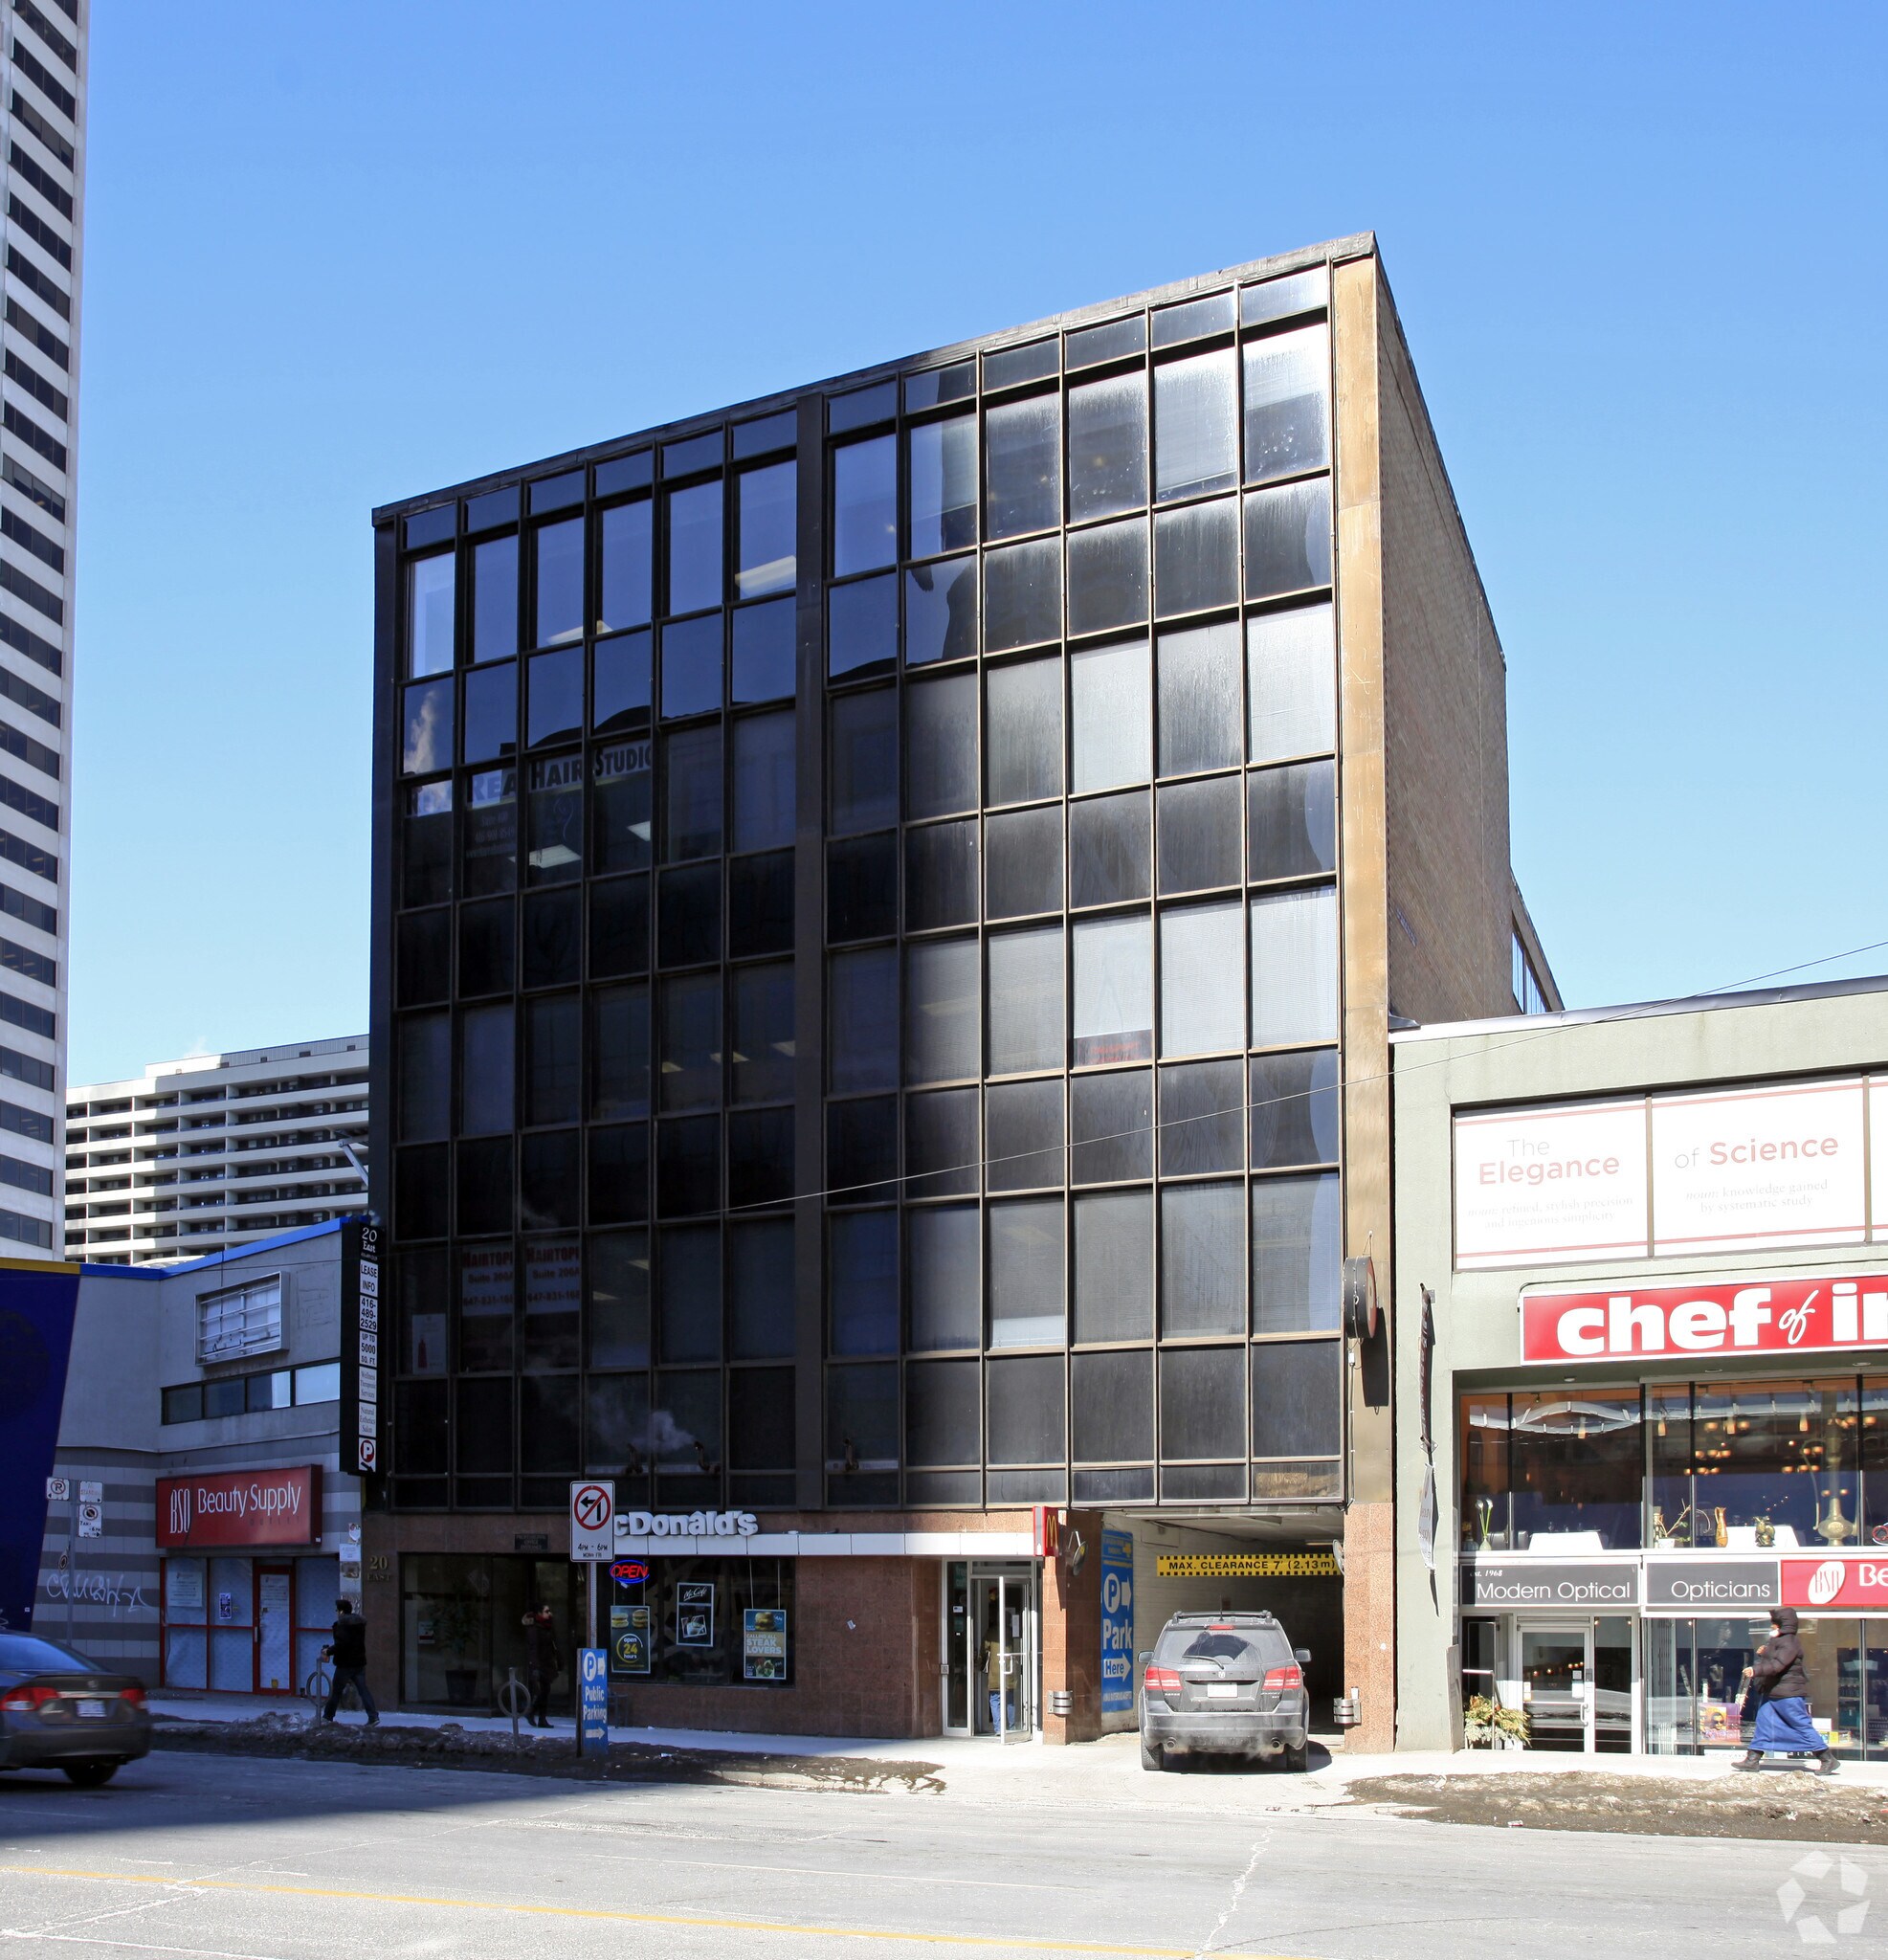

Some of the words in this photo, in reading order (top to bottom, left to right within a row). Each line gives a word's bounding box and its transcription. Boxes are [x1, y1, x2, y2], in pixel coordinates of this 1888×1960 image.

[531, 759, 582, 790] HAIR
[1506, 1138, 1550, 1157] The
[1675, 1147, 1699, 1169] of
[1709, 1137, 1839, 1166] Science
[1478, 1157, 1620, 1186] Elegance
[1723, 1182, 1786, 1198] knowledge
[1789, 1179, 1828, 1194] gained
[1545, 1198, 1580, 1213] stylish
[1584, 1195, 1633, 1211] precision
[1700, 1201, 1713, 1215] by
[1718, 1199, 1777, 1214] systematic
[1781, 1194, 1812, 1208] study
[1485, 1217, 1504, 1230] and
[1508, 1214, 1560, 1230] ingenious
[1562, 1210, 1615, 1225] simplicity
[362, 1227, 377, 1242] 20
[363, 1240, 376, 1253] East
[361, 1263, 377, 1279] LEASE
[363, 1281, 375, 1292] INFO
[362, 1298, 376, 1308] 416-
[362, 1308, 376, 1319] 489-
[1557, 1287, 1772, 1355] chef
[1778, 1289, 1819, 1346] of
[361, 1319, 377, 1330] 2529
[361, 1343, 375, 1354] 5000
[169, 1488, 190, 1534] BSO
[197, 1485, 248, 1518] Beauty
[250, 1481, 301, 1515] Supply
[613, 1510, 759, 1537] cDonald's
[369, 1555, 389, 1570] 20
[1168, 1561, 1196, 1570] MAX.
[1200, 1560, 1269, 1570] CLEARANCE
[1274, 1560, 1283, 1570] 7'
[611, 1564, 650, 1578] OPEN
[1485, 1569, 1503, 1577] 1968
[1477, 1582, 1551, 1599] Modern
[1557, 1581, 1631, 1602] Optical
[1671, 1580, 1770, 1601] Opticians
[746, 1638, 777, 1647] STEAK
[1102, 1618, 1133, 1651] Park
[624, 1643, 638, 1655] 24
[746, 1646, 782, 1655] LOVERS
[1105, 1659, 1124, 1675] Here
[585, 1685, 605, 1702] Public
[583, 1704, 607, 1724] Parking
